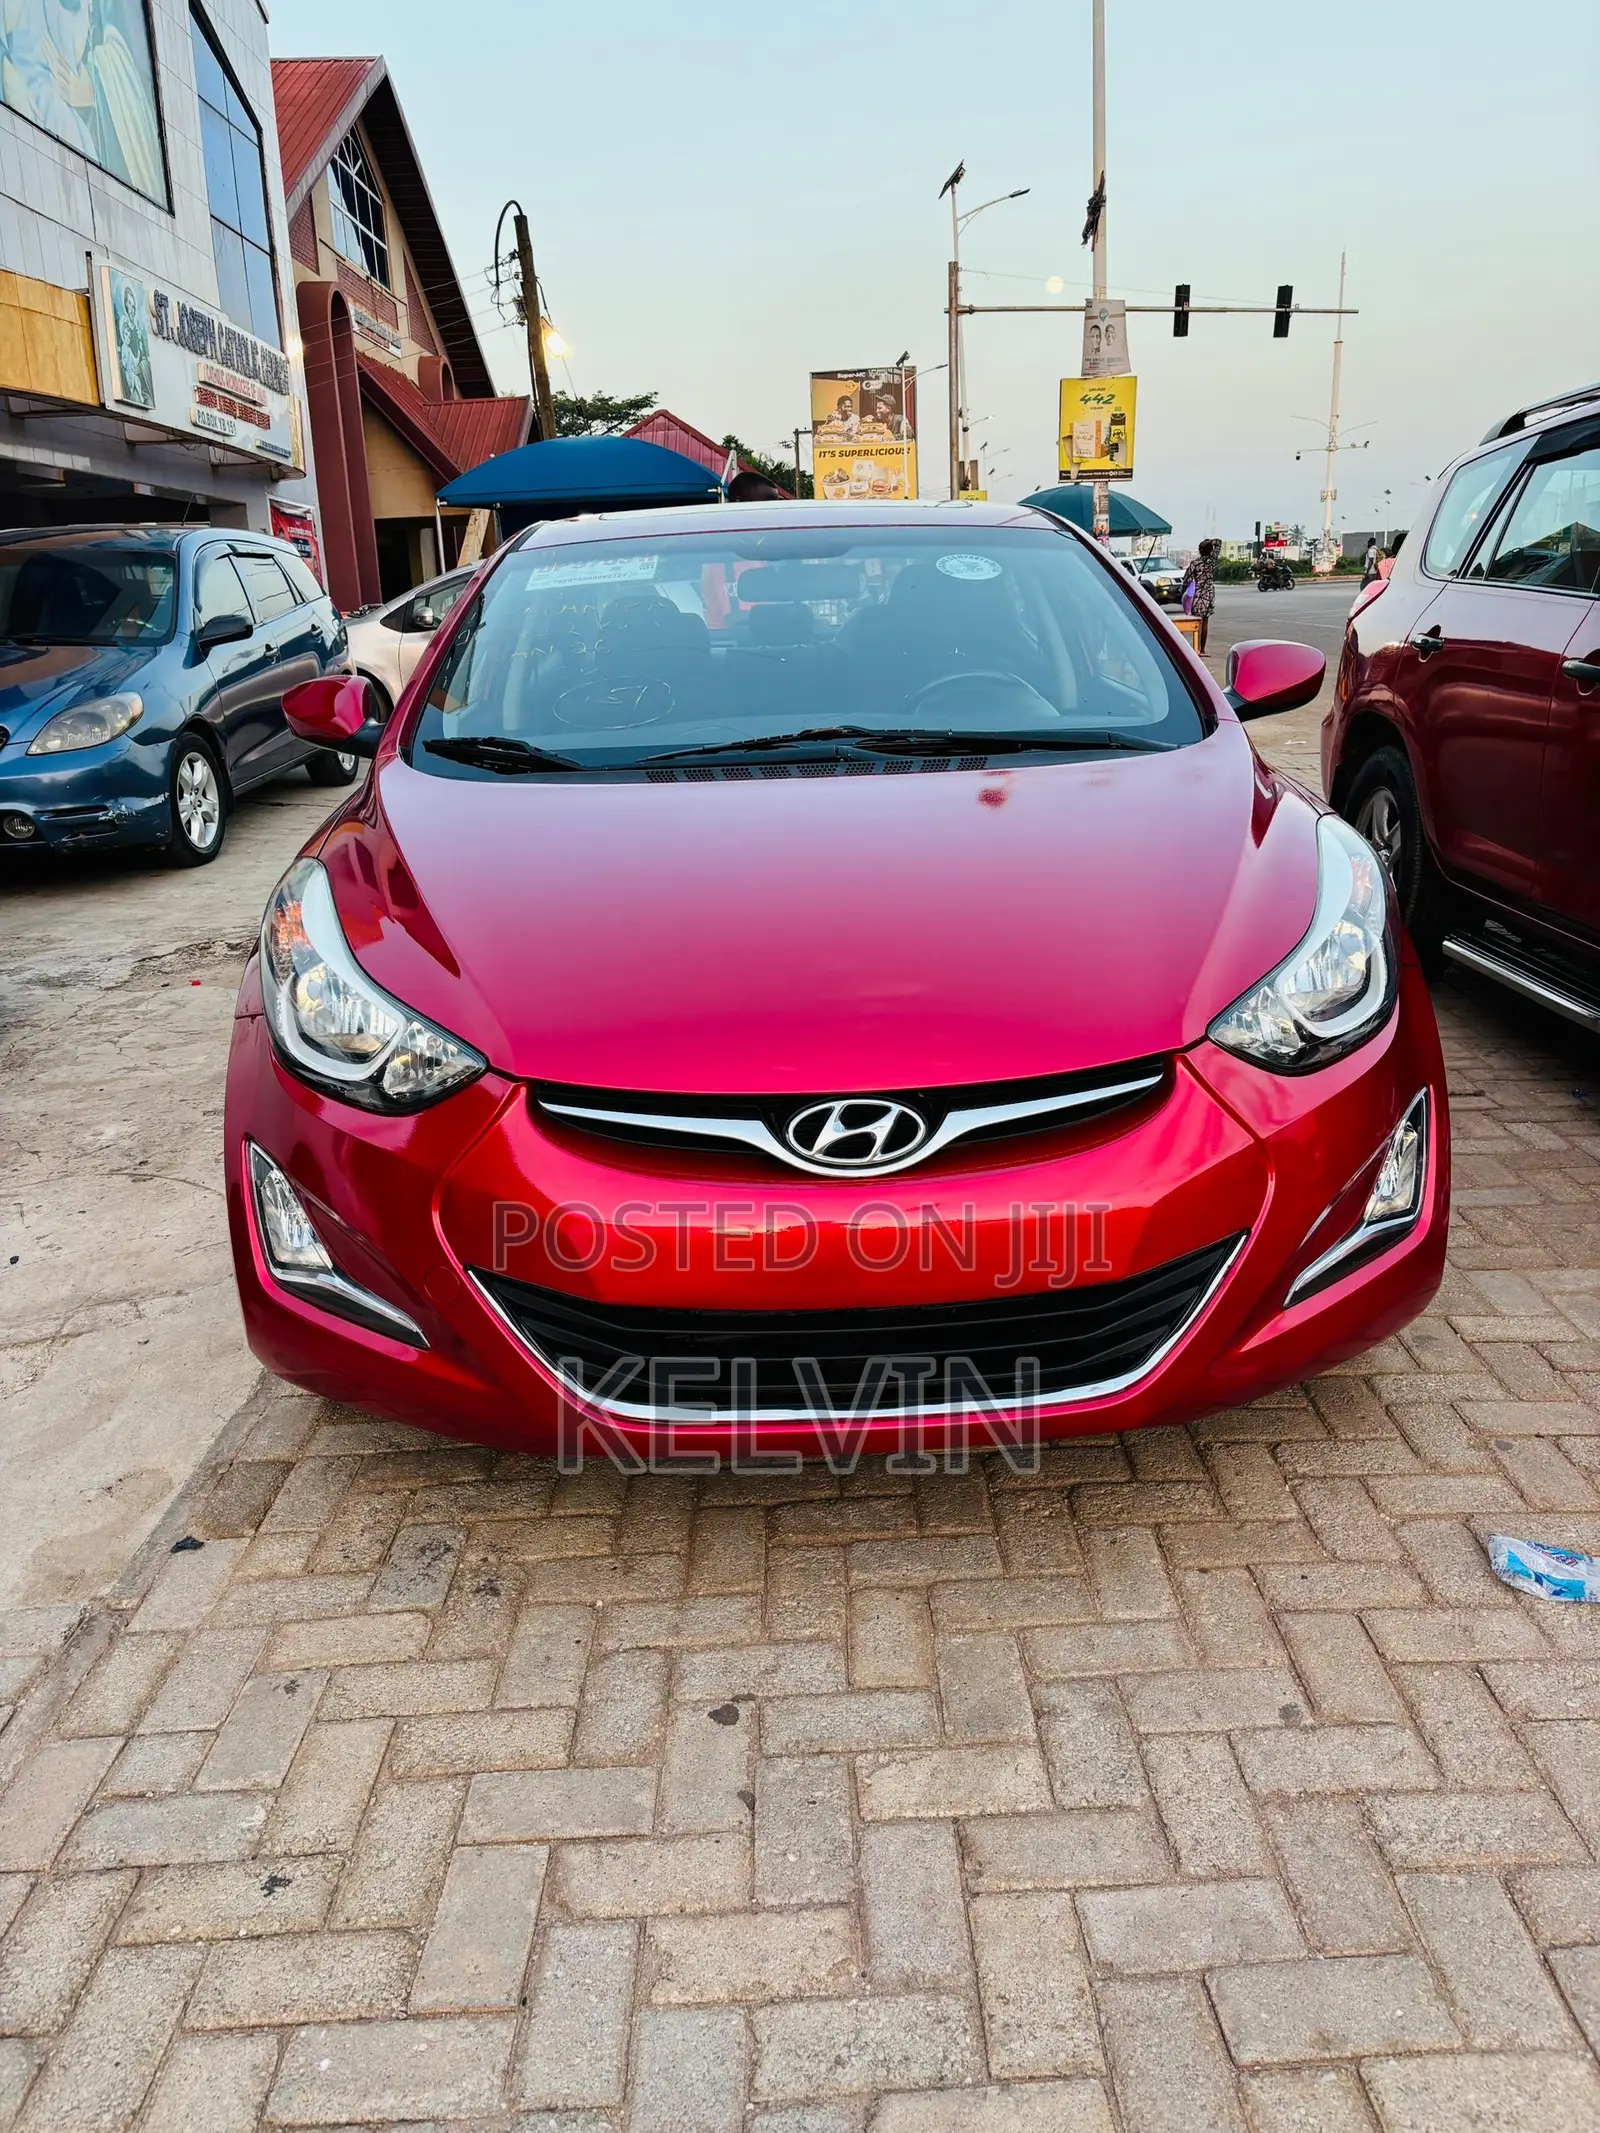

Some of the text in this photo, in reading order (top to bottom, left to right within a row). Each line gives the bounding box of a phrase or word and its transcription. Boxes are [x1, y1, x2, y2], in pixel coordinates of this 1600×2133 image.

[151, 289, 173, 341] ST.
[173, 301, 216, 360] JOSEPH
[1079, 393, 1115, 405] 442
[818, 450, 836, 459] IT'S
